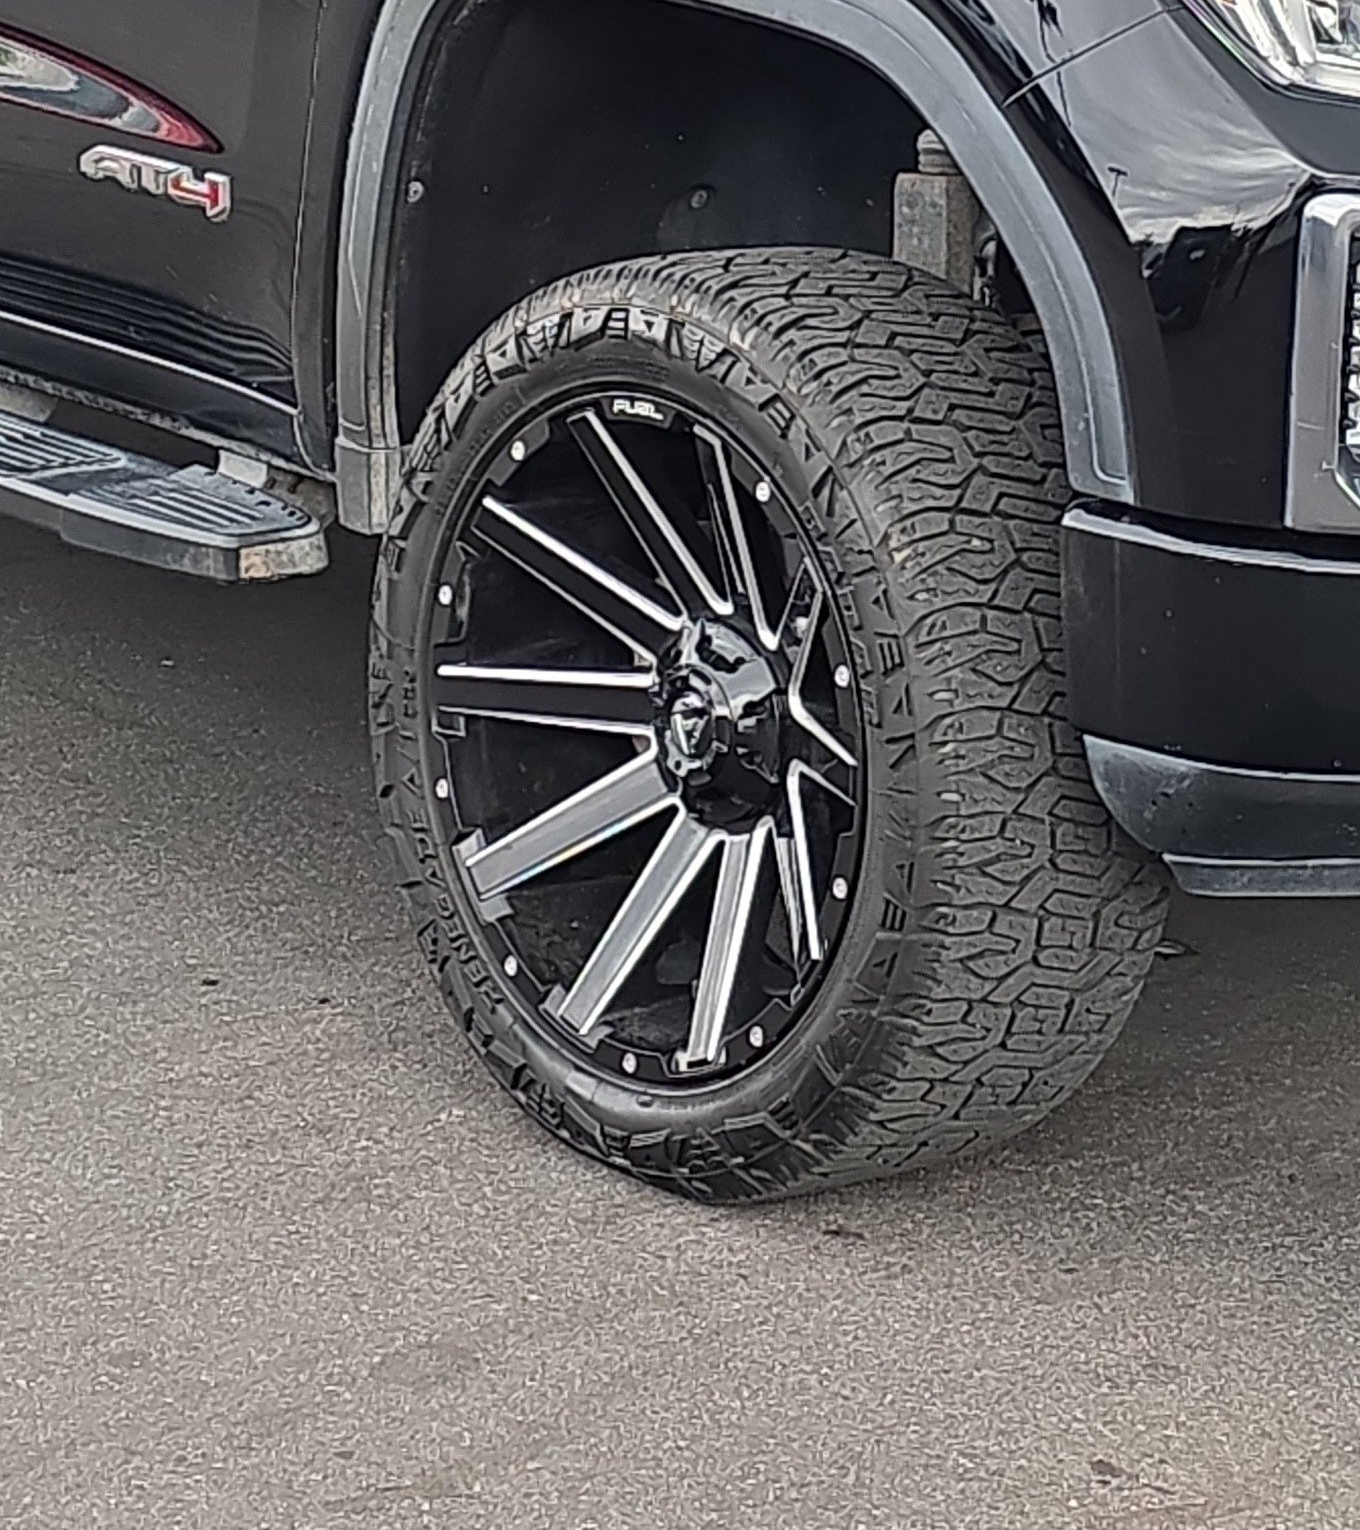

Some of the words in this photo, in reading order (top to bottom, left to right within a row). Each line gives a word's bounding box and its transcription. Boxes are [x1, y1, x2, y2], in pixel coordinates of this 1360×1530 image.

[80, 144, 232, 224] AT4
[611, 398, 664, 421] FUEL
[406, 808, 506, 1015] RENEGADE
